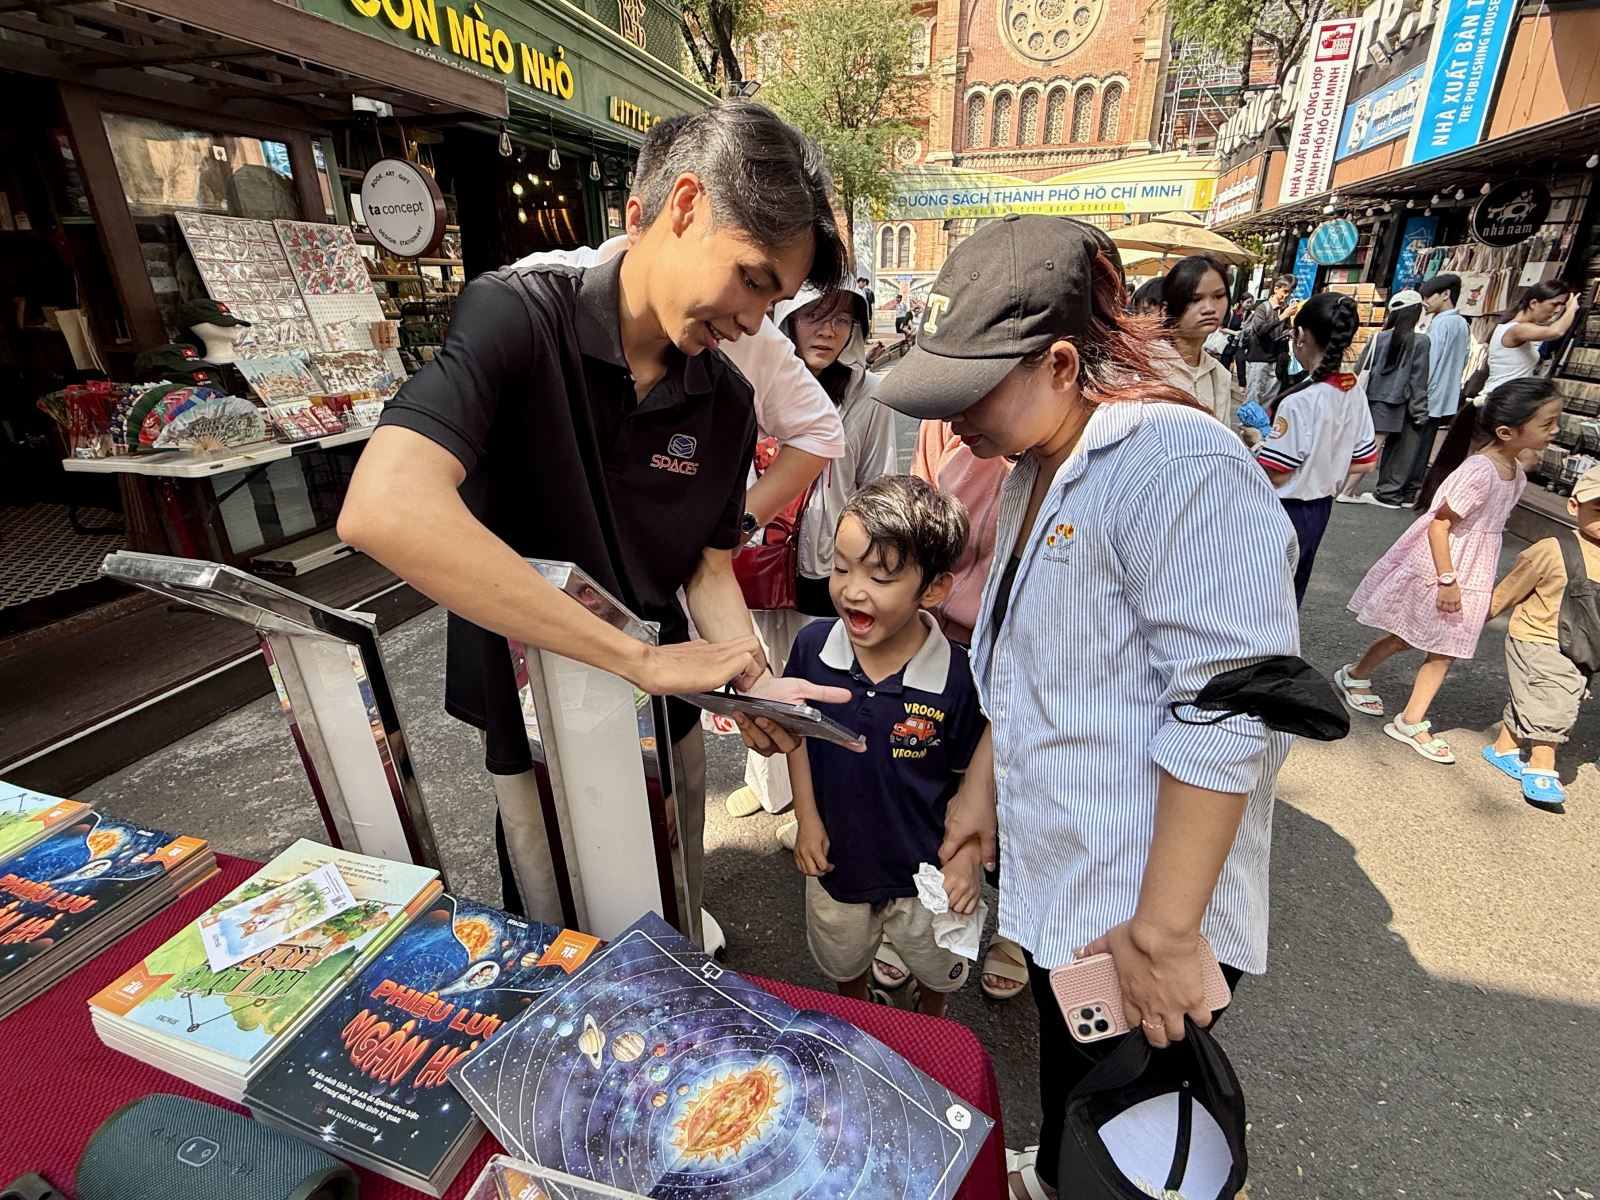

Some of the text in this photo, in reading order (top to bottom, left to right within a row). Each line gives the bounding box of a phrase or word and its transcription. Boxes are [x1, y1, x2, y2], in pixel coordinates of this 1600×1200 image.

[446, 2, 515, 74] MÈO
[520, 45, 574, 100] NHỎ
[1454, 14, 1481, 53] BẢN
[1442, 60, 1469, 104] XUẤT
[1458, 104, 1474, 124] TRE
[1466, 38, 1489, 103] PUBLISHING
[609, 96, 650, 133] LITTLE
[1289, 66, 1326, 198] NHÀ XUẤT BẢN TỔNG HỢP
[1304, 66, 1341, 198] THÀNH PHỐ HỒ CHÍ MINH
[1431, 109, 1457, 146] NHÀ
[370, 174, 383, 188] BOOK
[398, 174, 410, 185] GIFT
[898, 183, 1183, 208] ĐƯỜNG SÁCH THÀNH PHỐ HỒ CHÍ MINH
[368, 201, 424, 216] ta concept
[1081, 204, 1118, 212] STREET
[378, 226, 423, 246] DESIGN STATIONARY
[1507, 224, 1533, 235] nam
[923, 292, 951, 335] T
[904, 702, 945, 722] VROOM
[892, 748, 927, 759] VROOM
[371, 978, 455, 1024] PHIÊU
